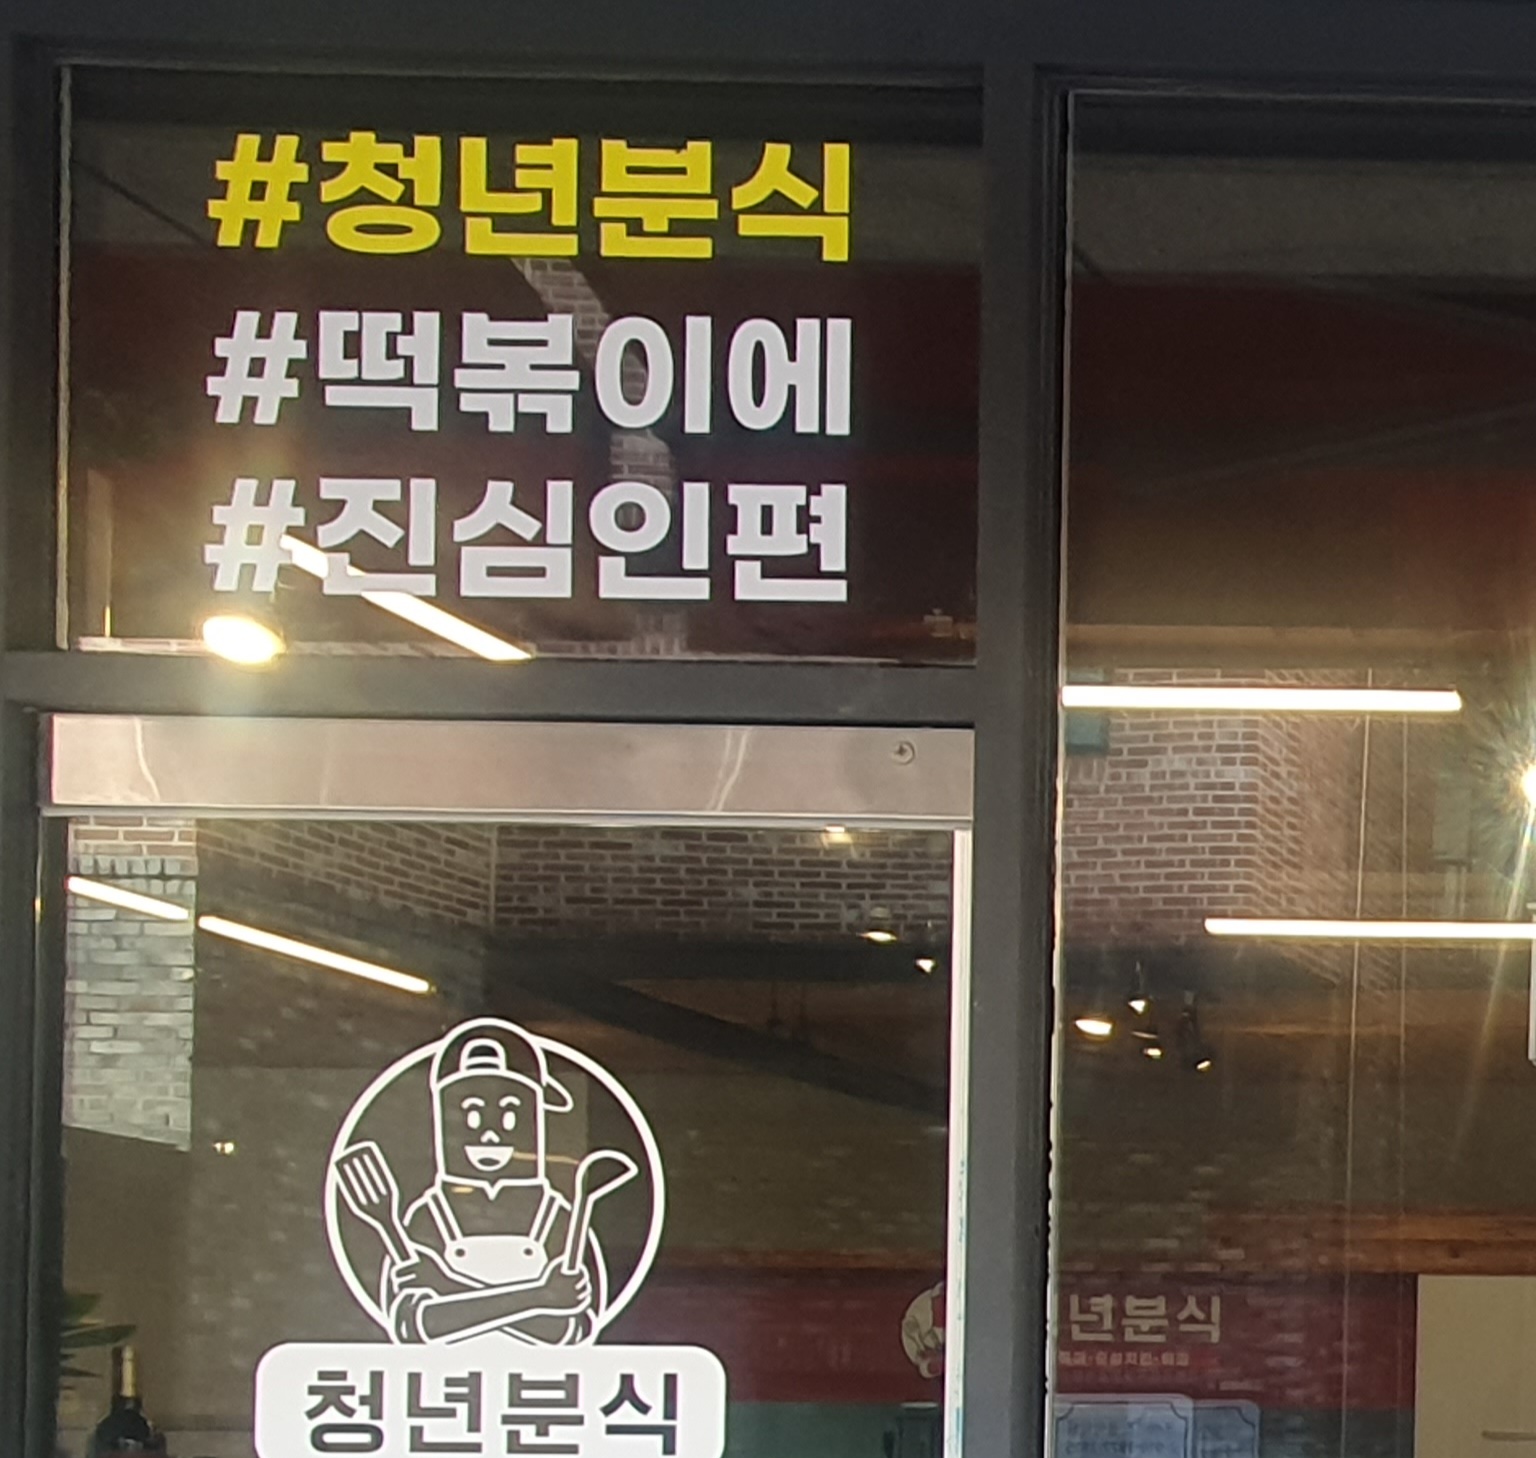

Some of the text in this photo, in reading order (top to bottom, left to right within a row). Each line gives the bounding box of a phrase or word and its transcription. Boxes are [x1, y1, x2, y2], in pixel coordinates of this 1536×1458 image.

[208, 131, 850, 261] #청년분식
[206, 310, 852, 435] #떡볶이에
[204, 478, 847, 602] #진심인편
[1069, 1293, 1221, 1343] 년분식
[305, 1370, 678, 1456] 청년분식
